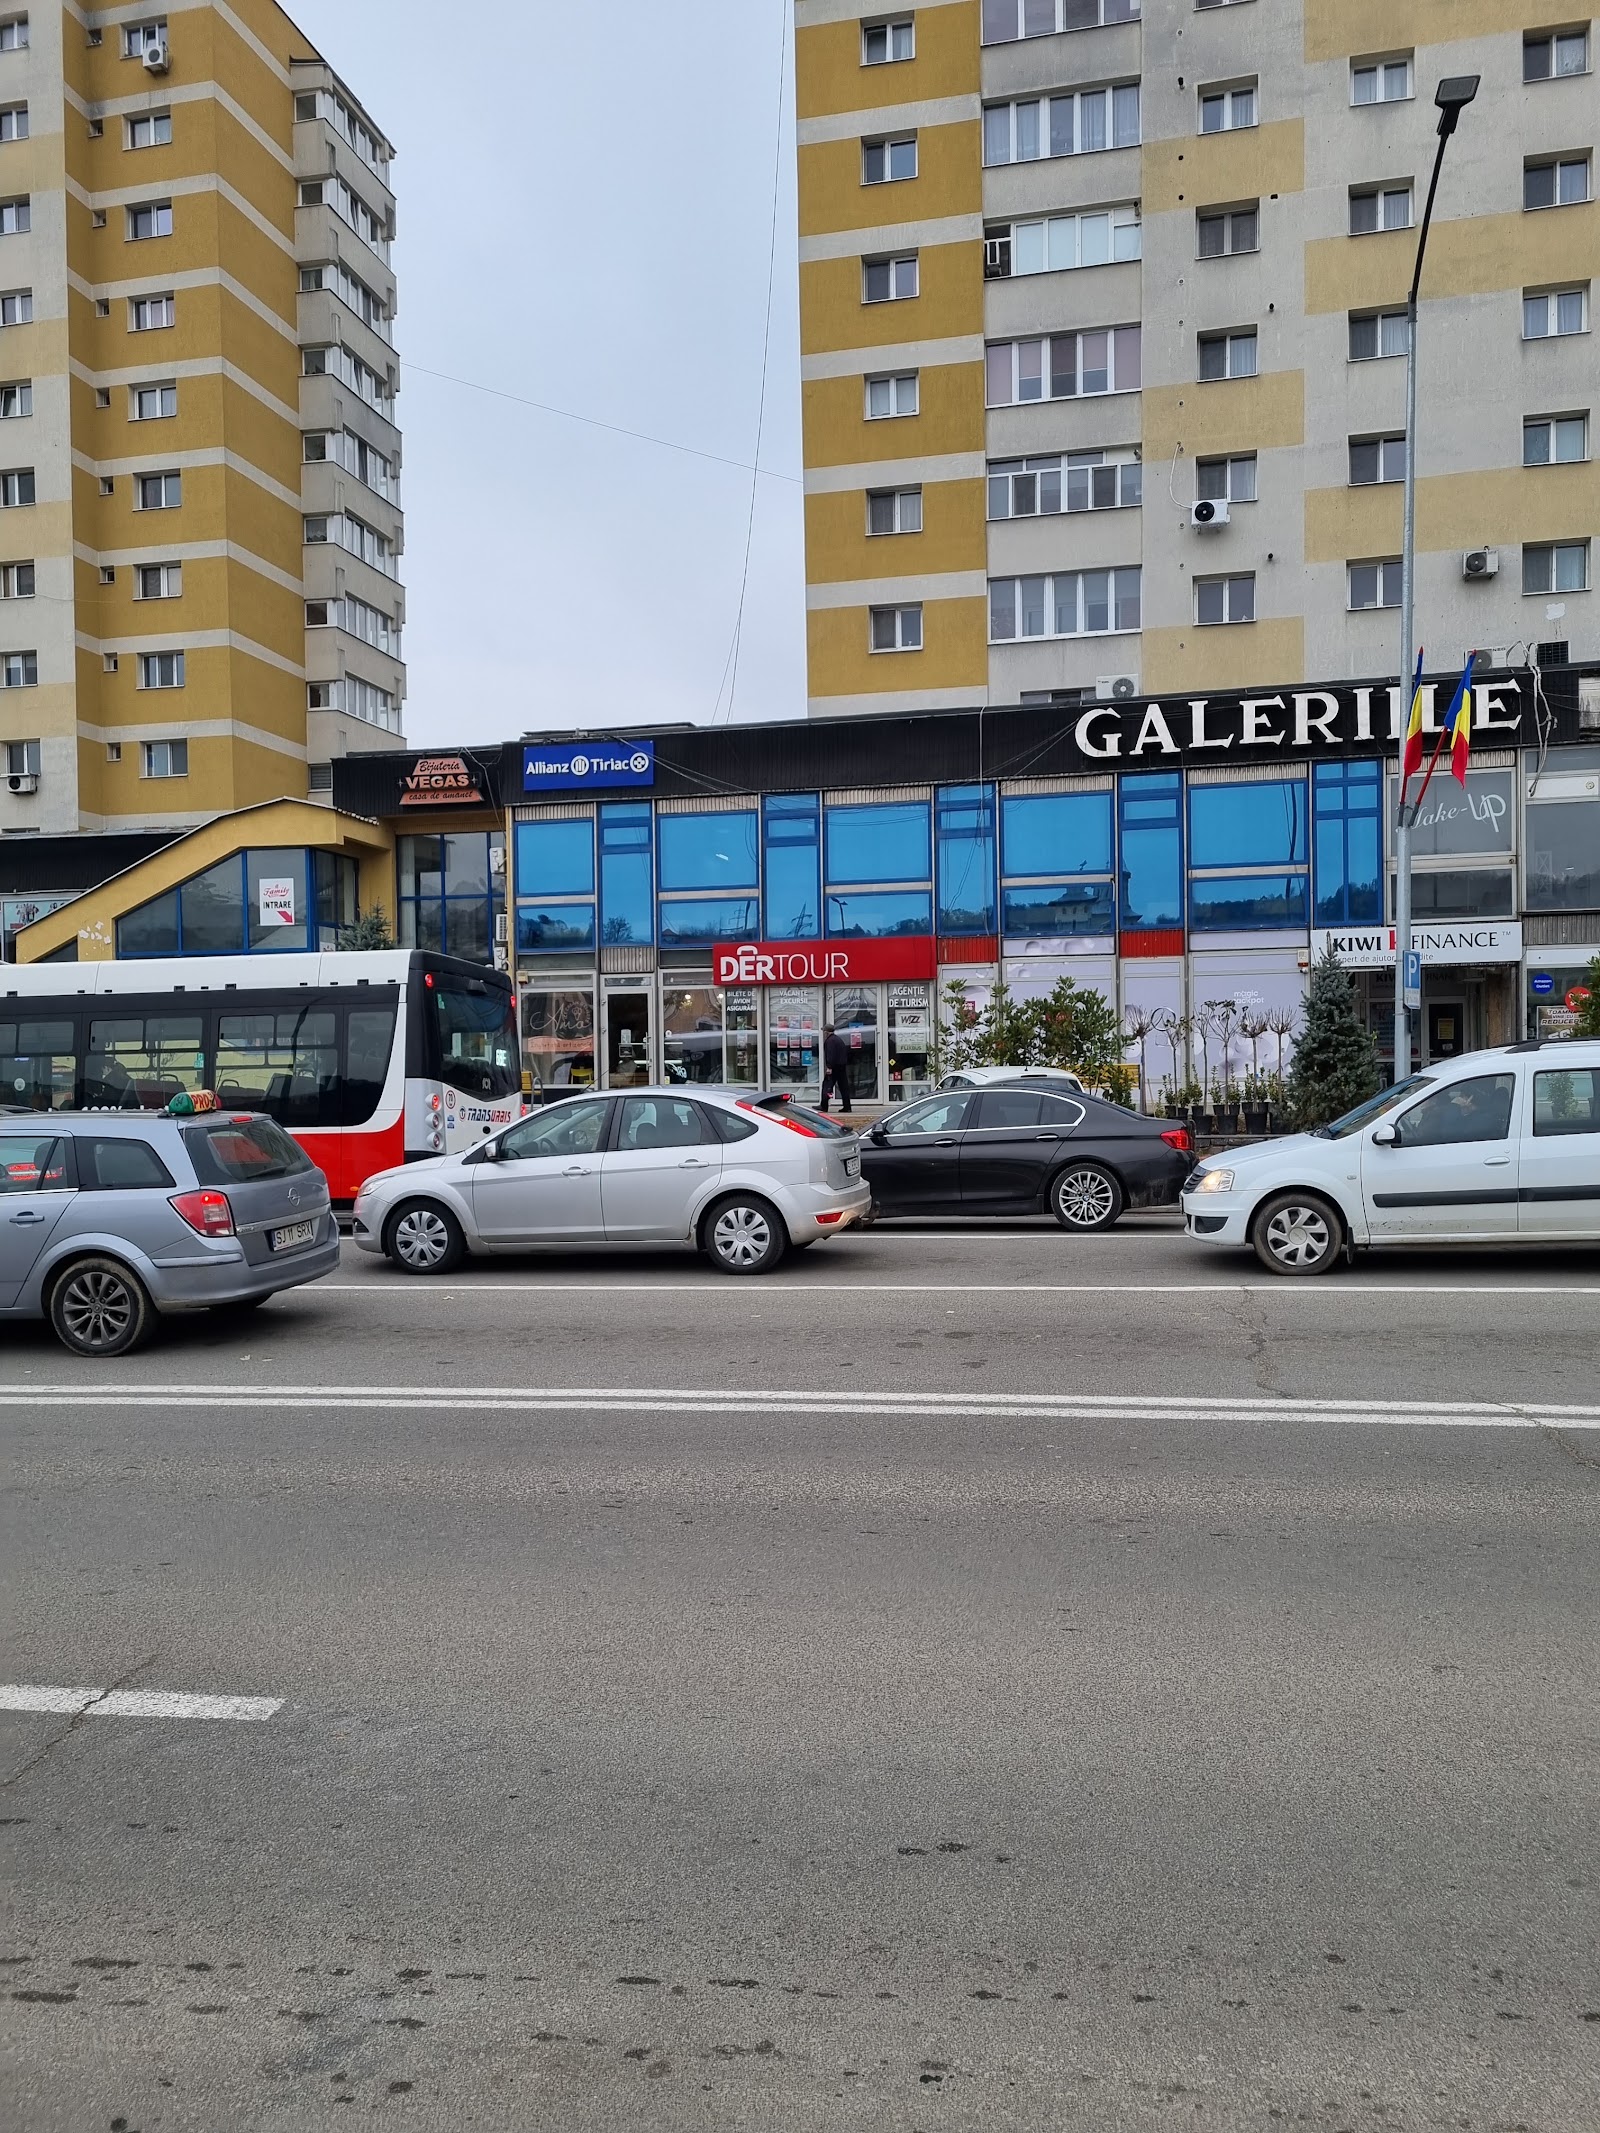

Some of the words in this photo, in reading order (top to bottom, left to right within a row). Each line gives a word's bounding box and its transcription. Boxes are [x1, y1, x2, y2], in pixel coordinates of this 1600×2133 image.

[1075, 677, 1522, 757] GALERIILE
[419, 760, 460, 774] Bijuteria
[525, 761, 569, 775] Allianz
[405, 774, 469, 789] VEGAS
[430, 790, 440, 799] de
[442, 790, 473, 799] amanet
[263, 900, 292, 909] INTRARE
[1333, 936, 1382, 952] KIWI
[1411, 931, 1500, 950] FINANCE
[720, 946, 849, 982] DERTOUR
[1335, 954, 1358, 964] xpert
[1360, 954, 1370, 963] de
[1372, 953, 1395, 964] ajutor
[1408, 954, 1418, 987] P
[892, 985, 925, 997] AGENȚIE
[1233, 989, 1259, 999] magic
[889, 998, 898, 1007] DE
[900, 997, 929, 1007] TURISM
[276, 1230, 286, 1244] SJ
[288, 1228, 294, 1241] 11
[297, 1221, 311, 1239] SRX
